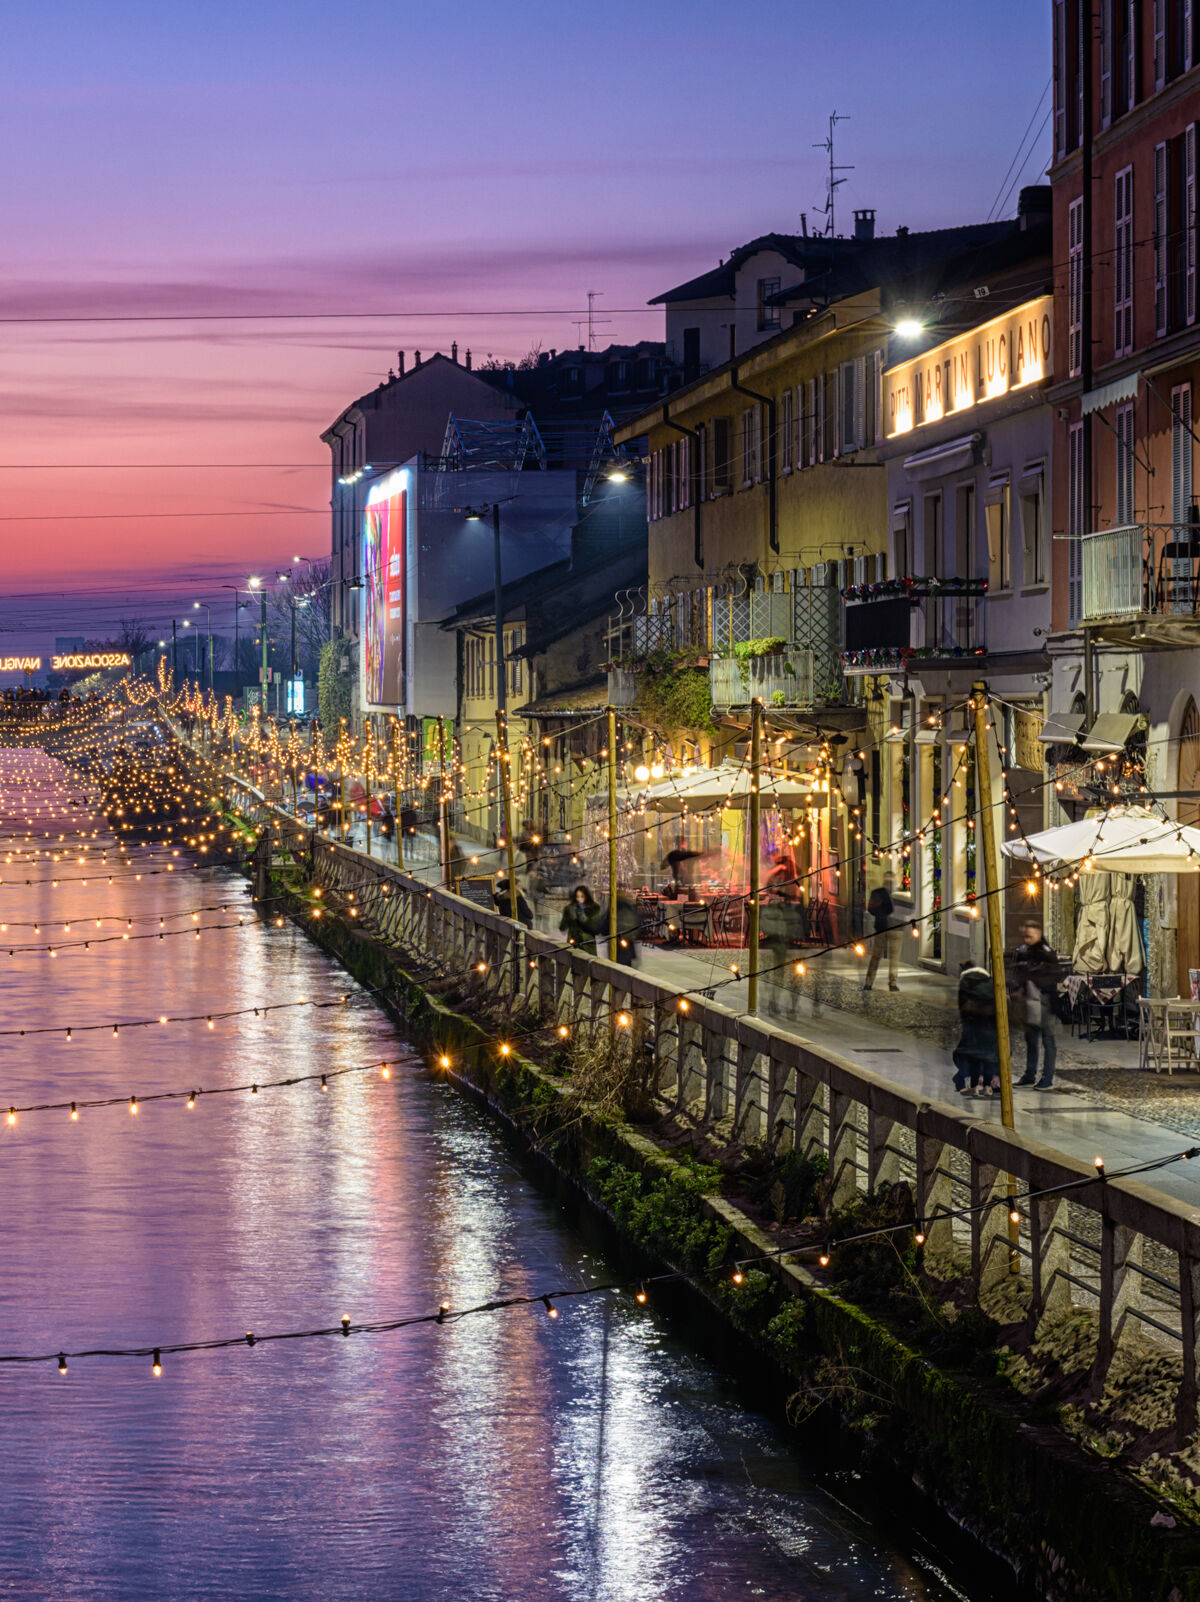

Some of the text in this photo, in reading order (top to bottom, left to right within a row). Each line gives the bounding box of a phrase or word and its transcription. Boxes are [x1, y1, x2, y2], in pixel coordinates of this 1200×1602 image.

[890, 313, 1050, 417] DITTA MARTIN LUCIANO
